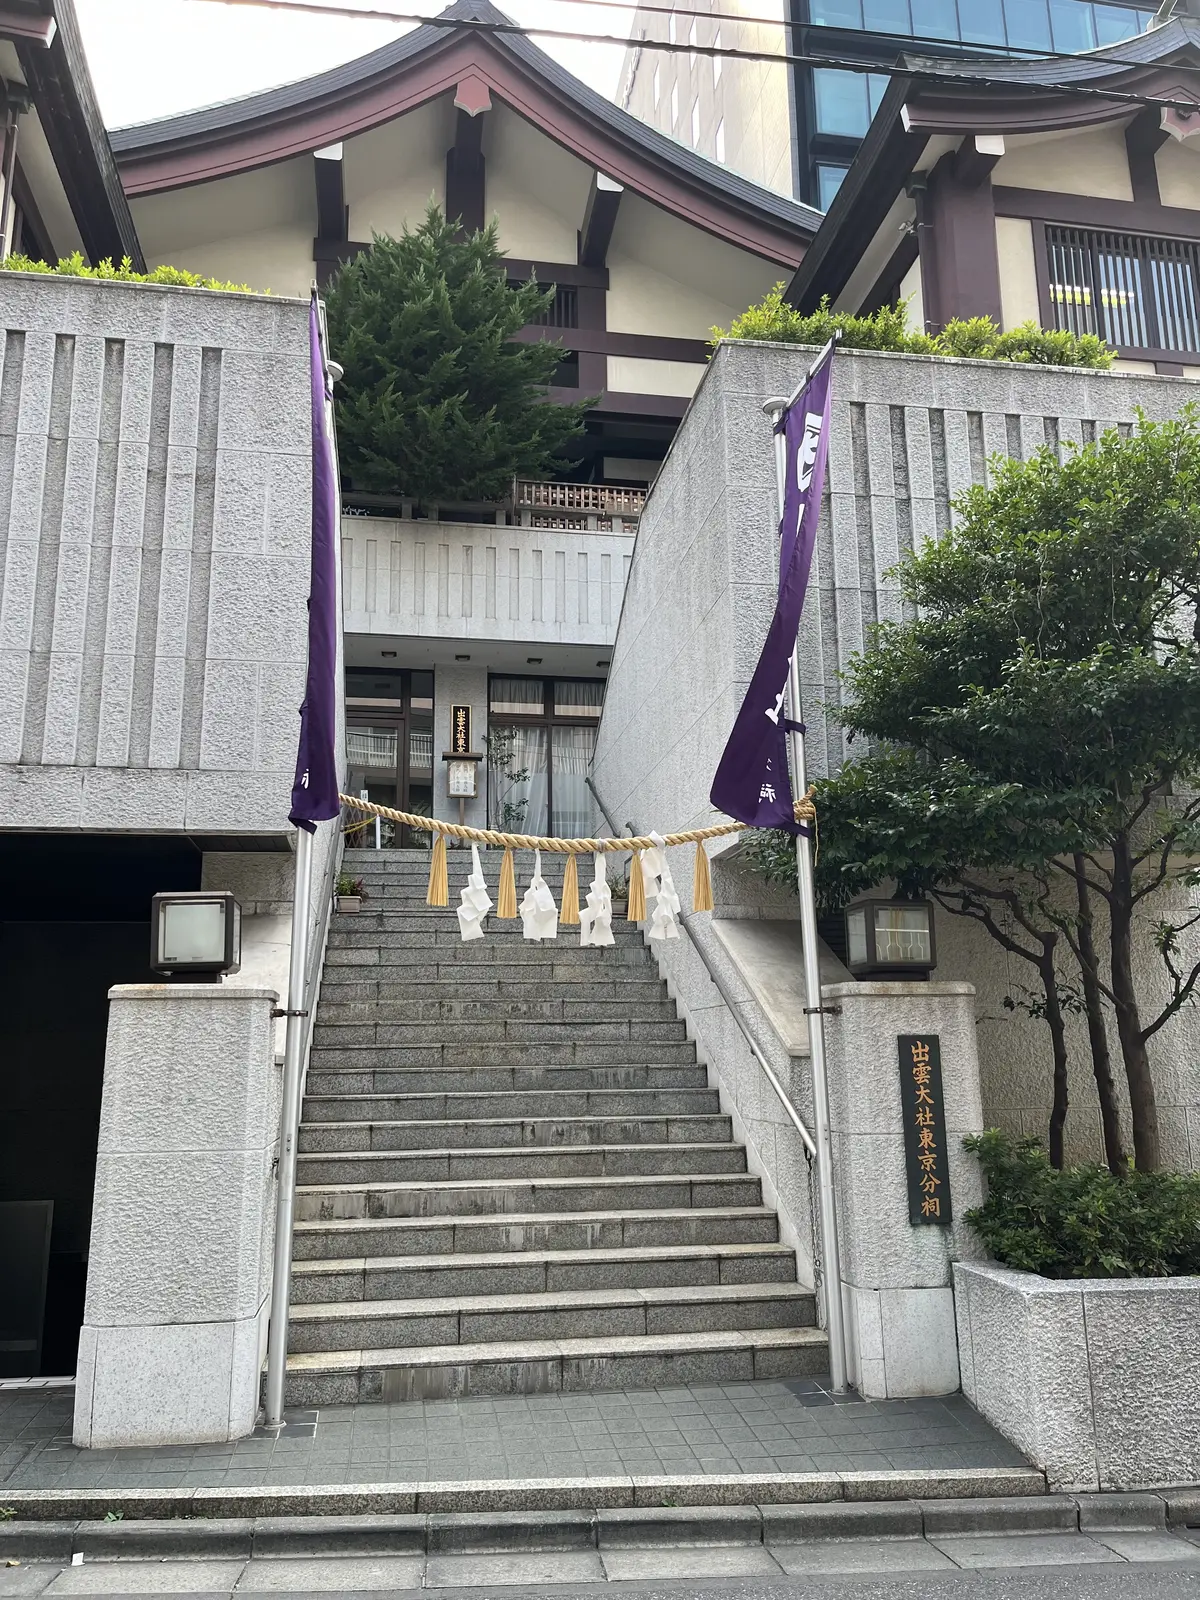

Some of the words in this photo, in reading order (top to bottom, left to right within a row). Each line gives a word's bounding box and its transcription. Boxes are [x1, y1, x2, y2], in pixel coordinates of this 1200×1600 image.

[911, 1041, 941, 1217] 出雲大社東京分祠
